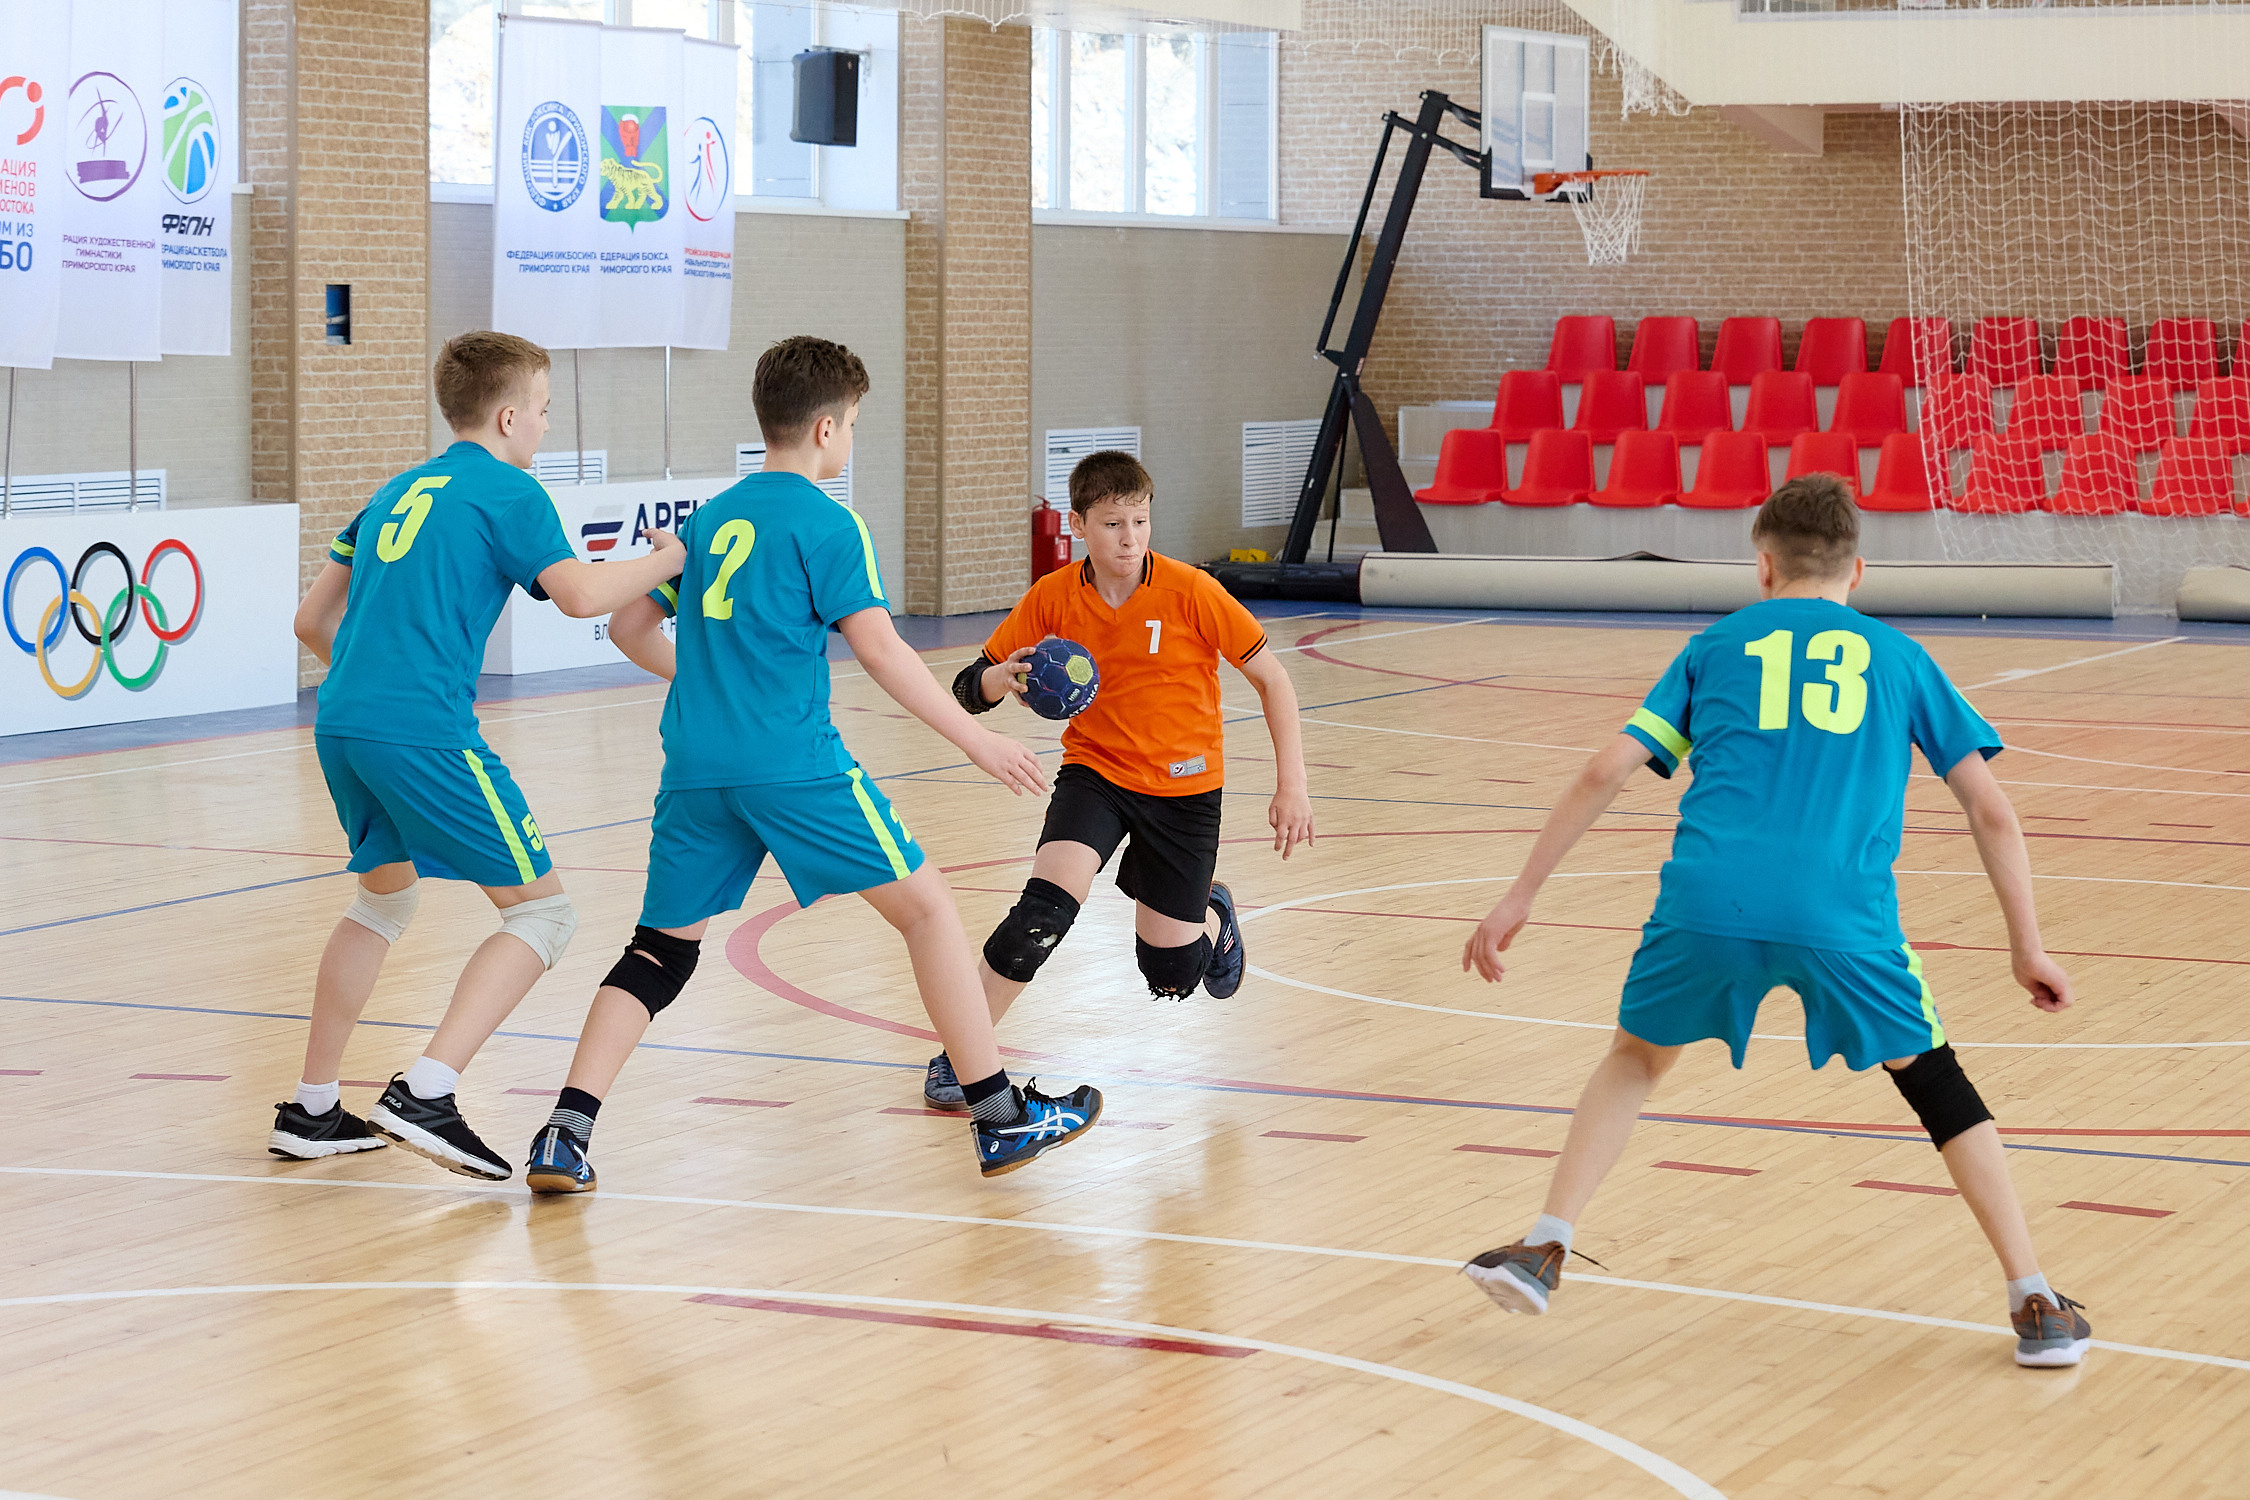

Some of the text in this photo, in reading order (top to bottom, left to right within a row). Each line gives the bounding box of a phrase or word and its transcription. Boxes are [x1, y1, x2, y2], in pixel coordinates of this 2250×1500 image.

[17, 222, 34, 238] ИЗ
[75, 248, 122, 260] ГИМНАСТИКИ
[506, 250, 554, 261] ФЕДЕРАЦИЯ
[641, 251, 669, 261] БОКСА
[115, 264, 136, 273] КРАЯ
[203, 262, 220, 272] КРАЯ
[571, 264, 590, 274] КРАЯ
[651, 264, 672, 274] КРАЯ
[375, 475, 452, 563] 5
[702, 518, 756, 621] 2
[1145, 619, 1162, 654] 7
[1744, 629, 1871, 735] 13
[520, 812, 544, 852] 5
[384, 1095, 403, 1109] FILA
